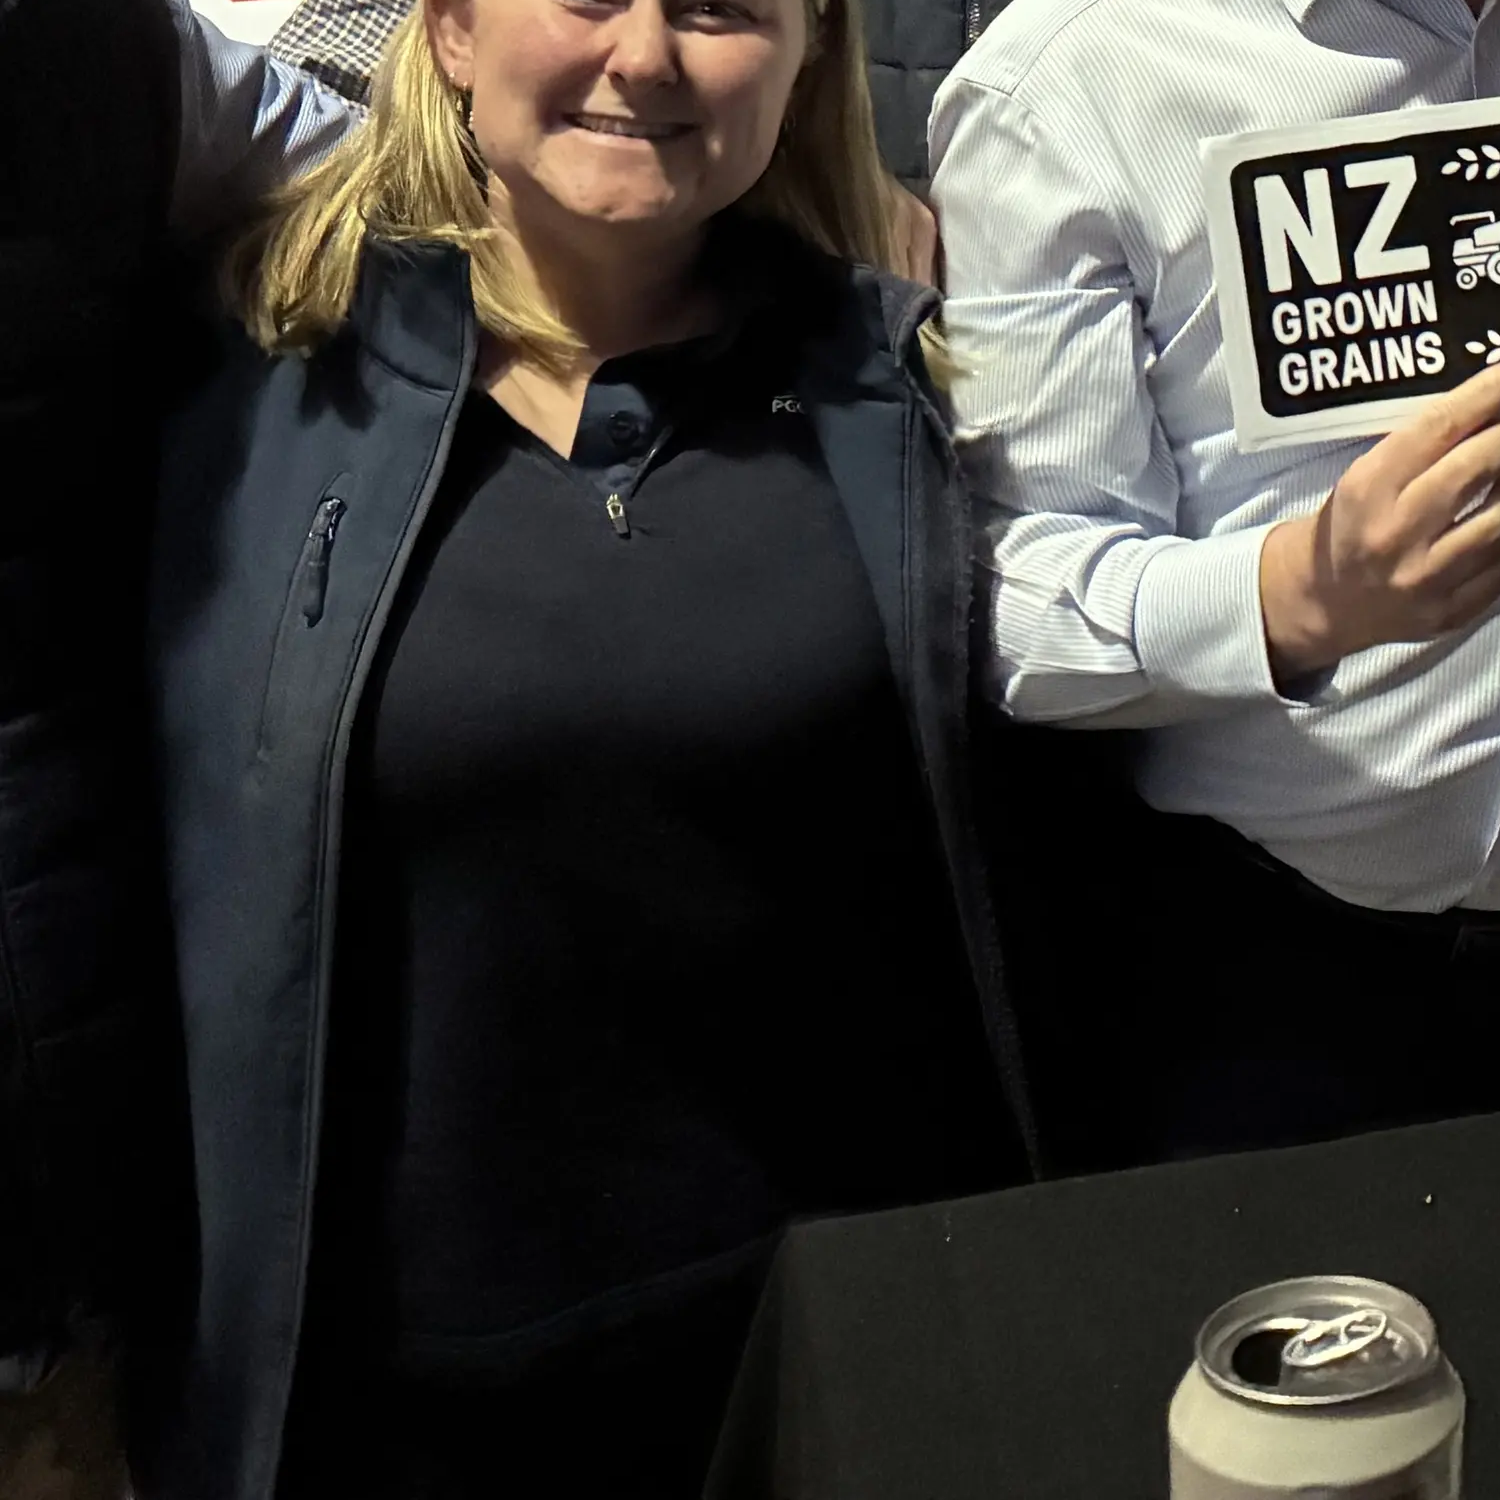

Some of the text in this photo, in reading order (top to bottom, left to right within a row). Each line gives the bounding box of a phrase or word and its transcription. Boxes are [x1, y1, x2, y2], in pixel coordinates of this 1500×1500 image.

[1253, 155, 1431, 293] NZ
[1272, 280, 1438, 344] GROWN
[1279, 331, 1445, 396] GRAINS
